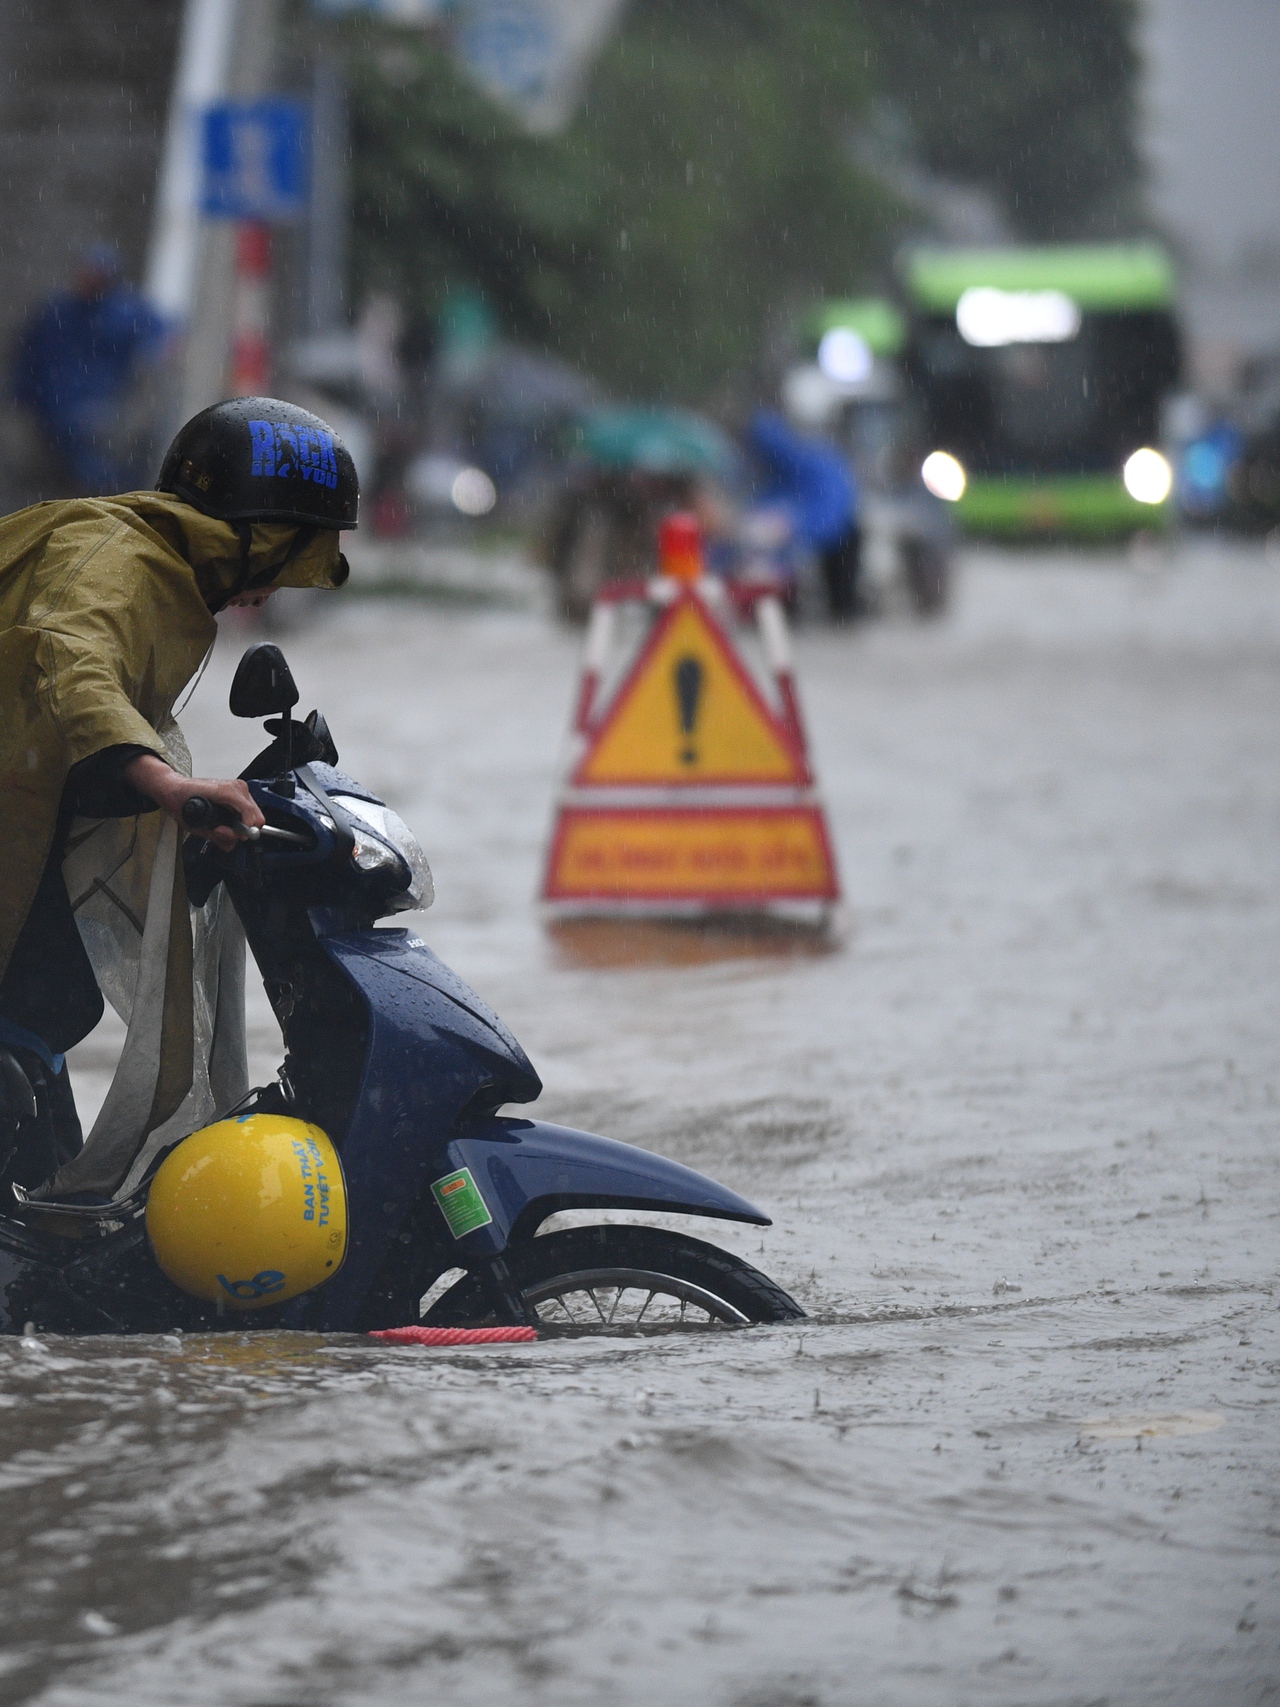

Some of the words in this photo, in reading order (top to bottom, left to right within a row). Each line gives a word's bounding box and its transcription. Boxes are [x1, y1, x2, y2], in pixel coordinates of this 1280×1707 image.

[300, 464, 339, 490] YOU
[303, 1184, 318, 1221] BẠN
[317, 1172, 331, 1227] TUYỆT
[216, 1270, 286, 1300] be
